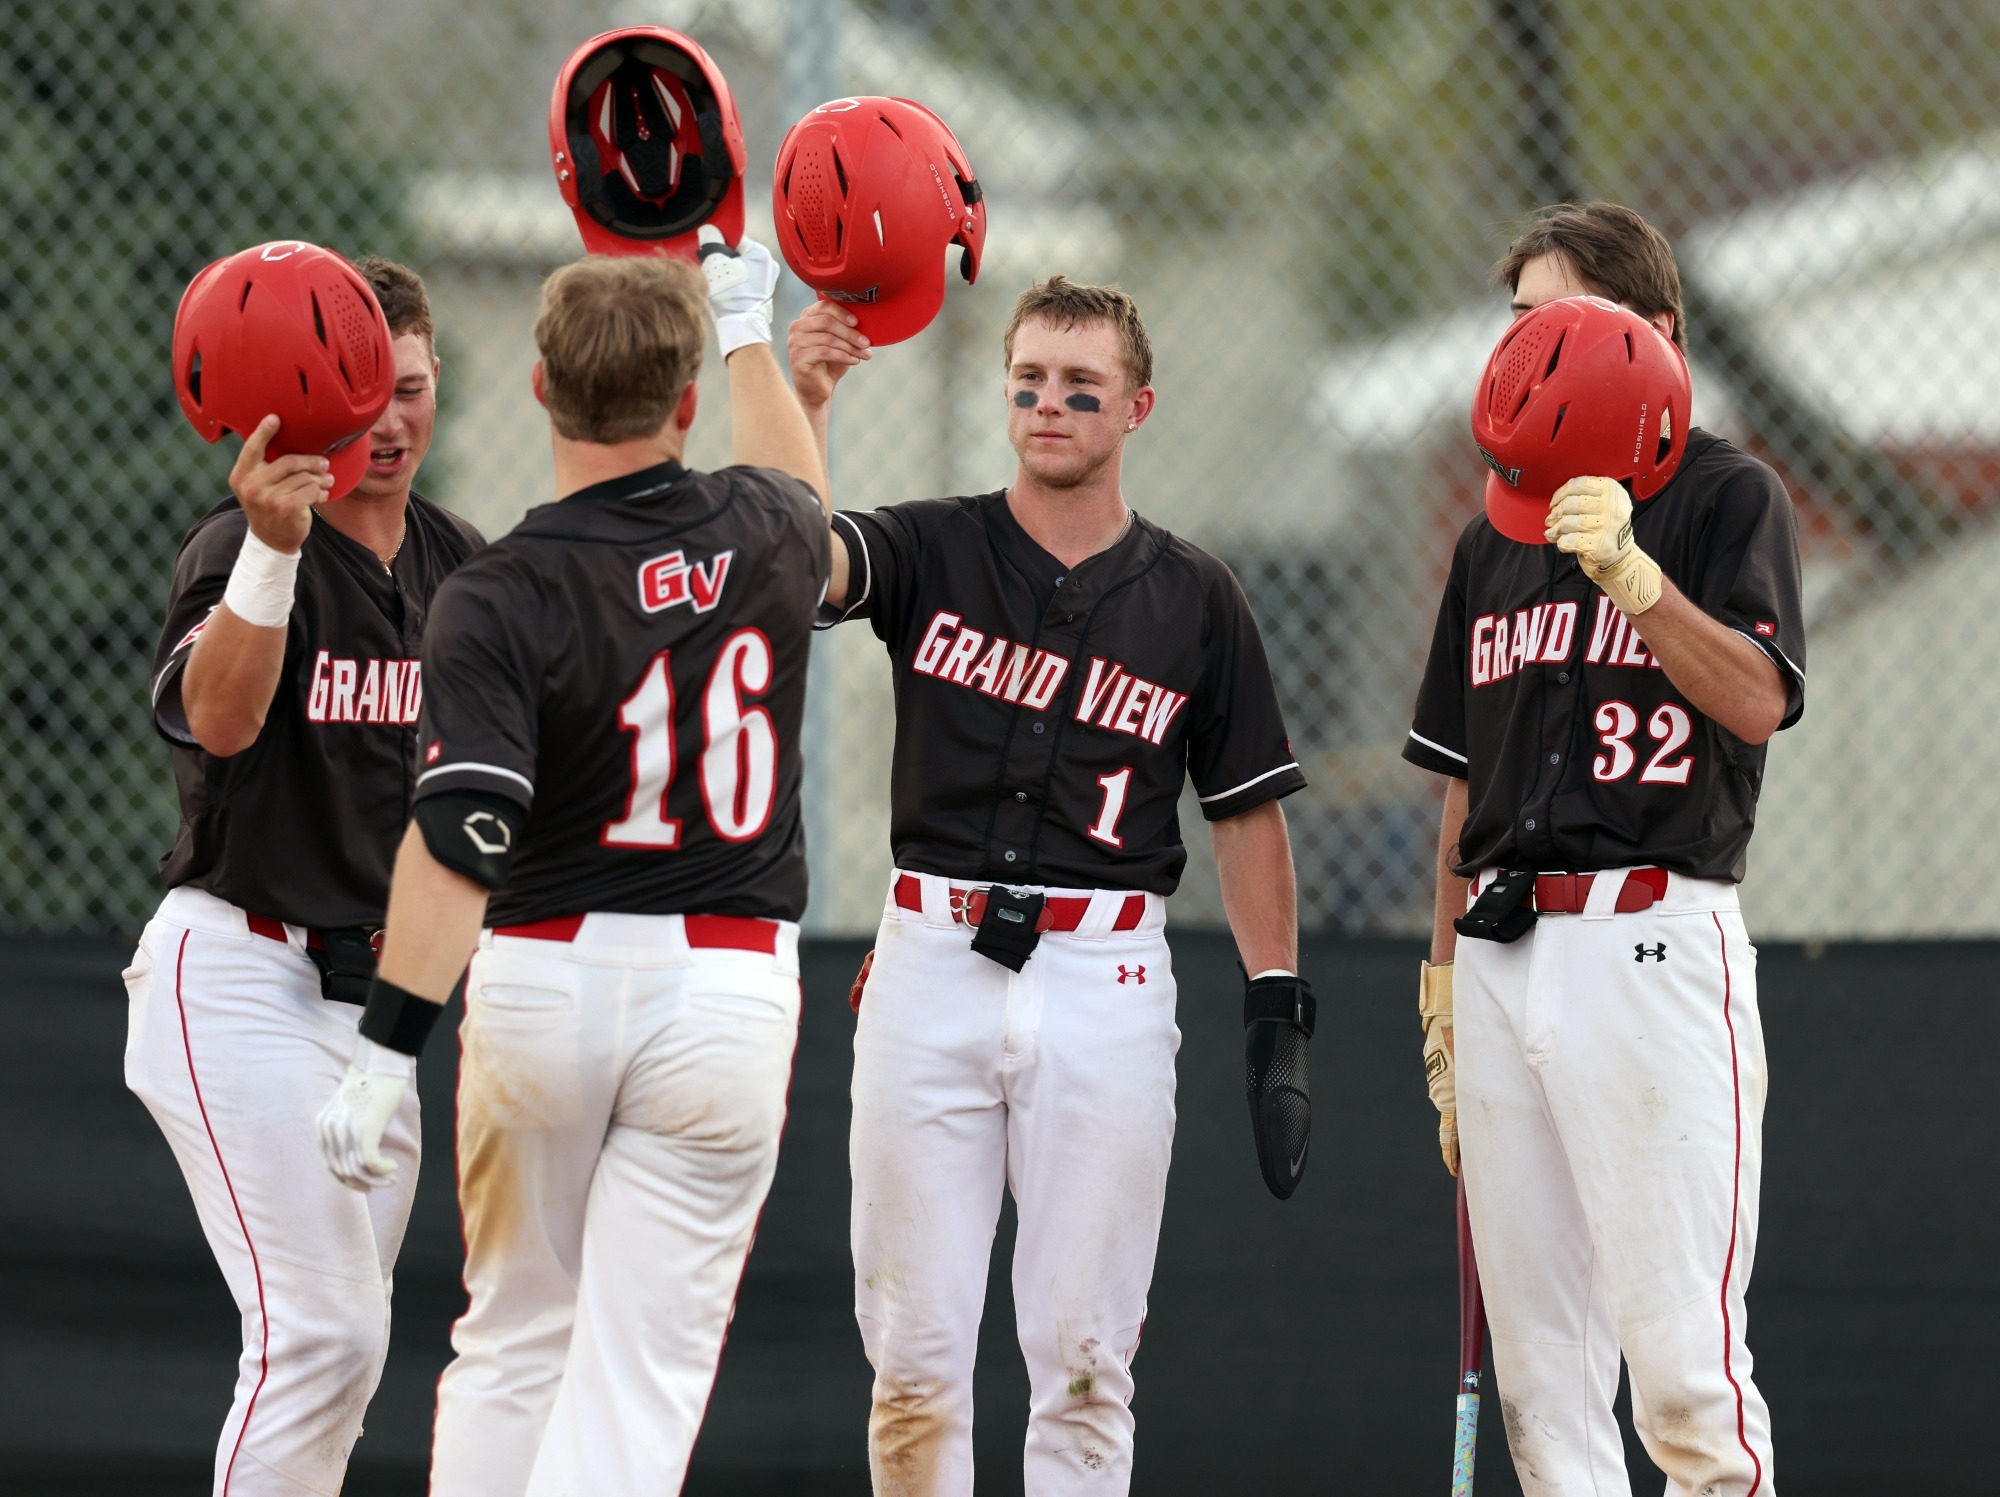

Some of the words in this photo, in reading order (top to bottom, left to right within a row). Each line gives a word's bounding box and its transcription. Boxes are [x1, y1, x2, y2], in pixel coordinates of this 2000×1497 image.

[929, 163, 956, 220] EVOSHIELD
[1633, 403, 1647, 463] EVOSHIELD
[637, 549, 734, 614] GV
[912, 609, 1070, 712] GRAND
[1074, 655, 1190, 746] VIEW
[1470, 600, 1578, 688] GRAND
[1584, 593, 1664, 669] VIE
[307, 648, 423, 725] GRAND
[599, 626, 779, 850] 16
[1592, 699, 1695, 786] 32
[1087, 765, 1133, 848] 1
